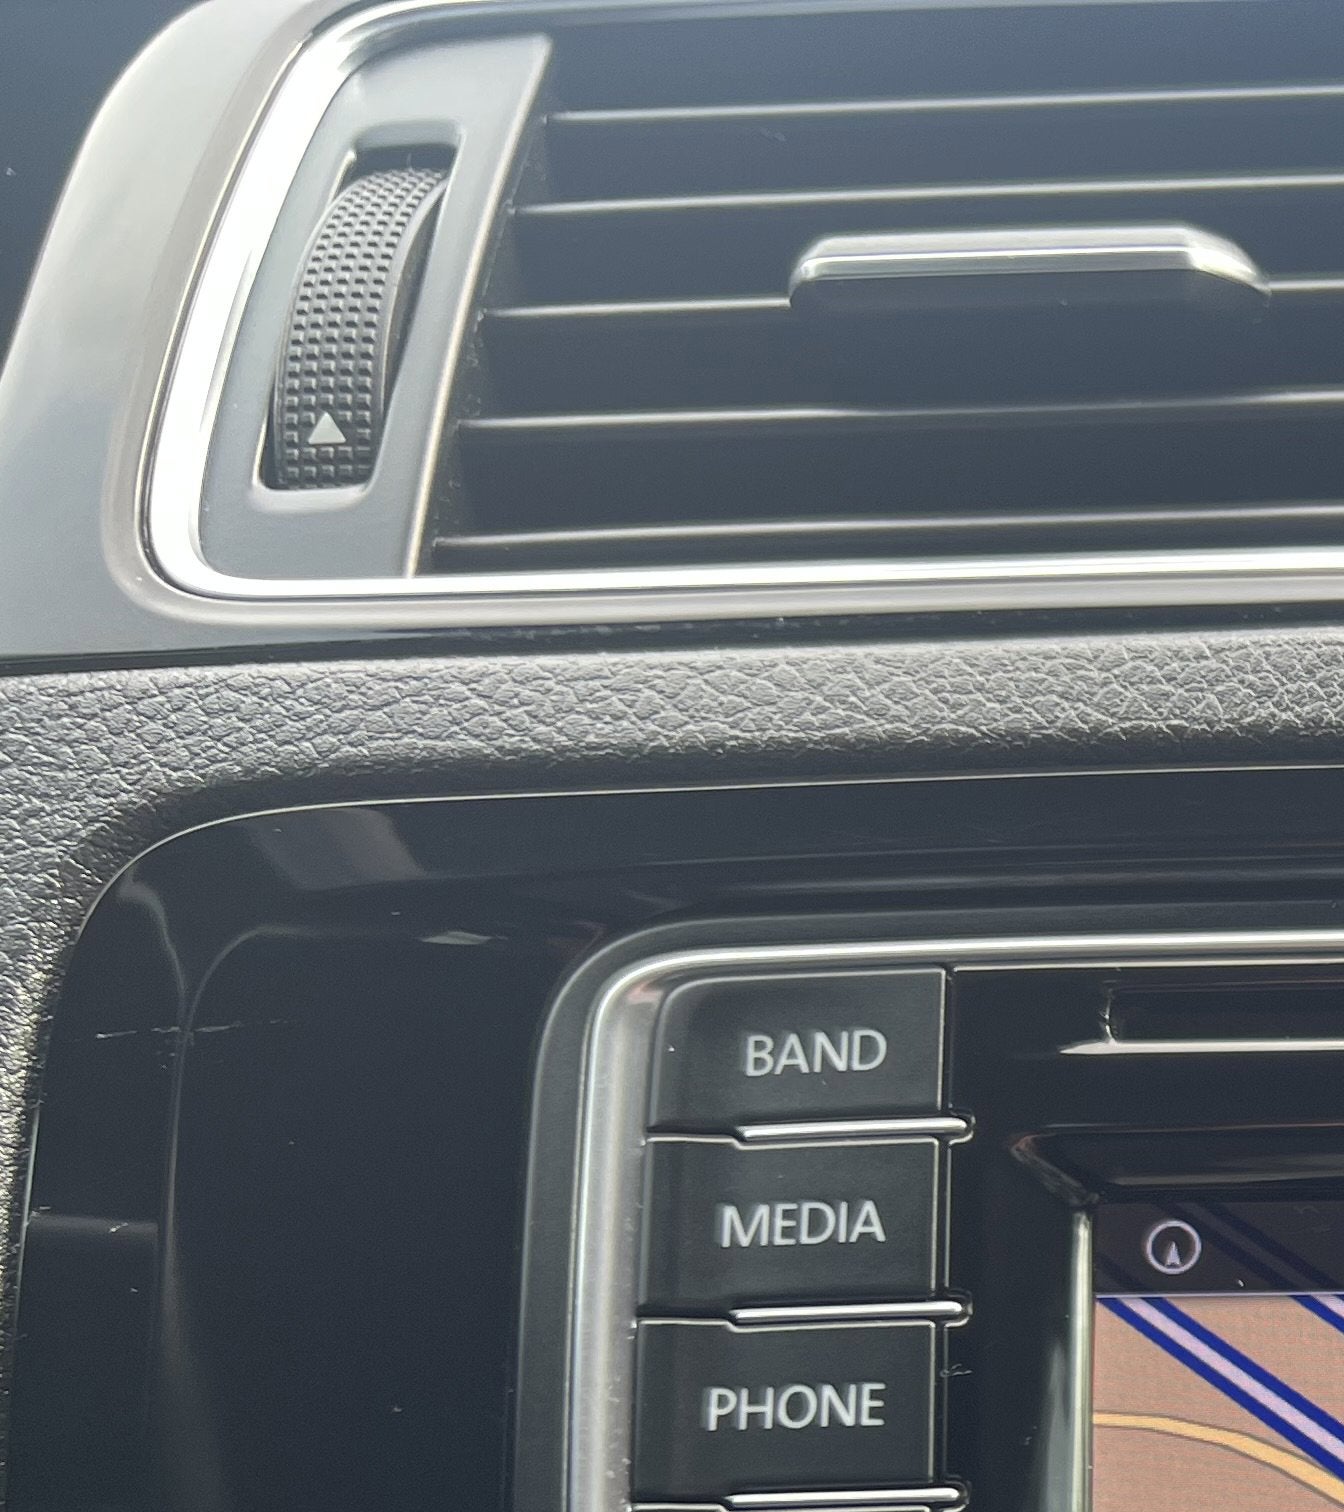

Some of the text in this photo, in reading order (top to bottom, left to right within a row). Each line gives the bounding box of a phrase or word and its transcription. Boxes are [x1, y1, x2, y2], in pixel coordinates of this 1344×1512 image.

[744, 1029, 887, 1077] BAND
[718, 1200, 886, 1248] MEDIA
[706, 1382, 886, 1431] PHONE
